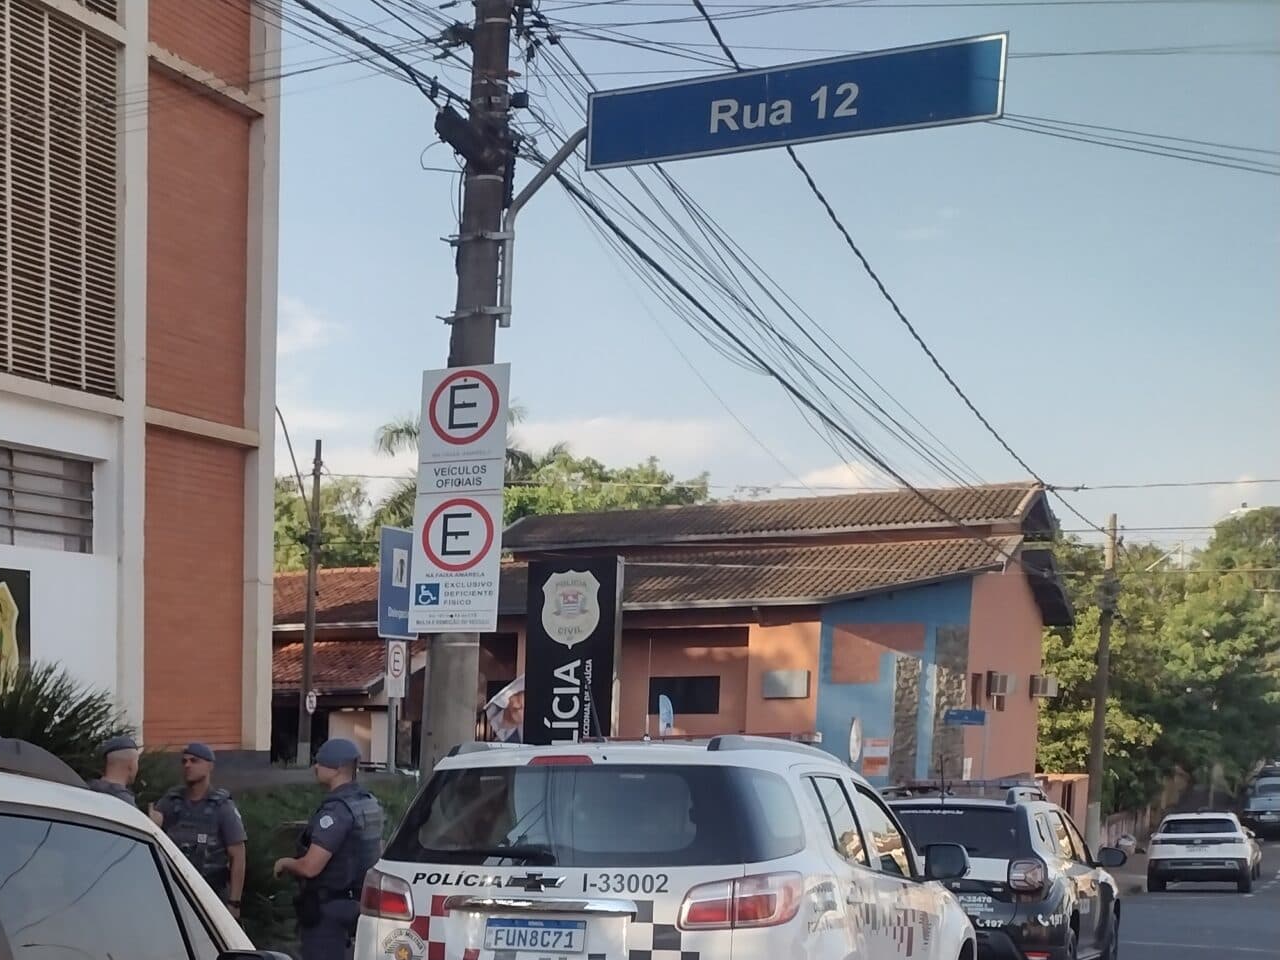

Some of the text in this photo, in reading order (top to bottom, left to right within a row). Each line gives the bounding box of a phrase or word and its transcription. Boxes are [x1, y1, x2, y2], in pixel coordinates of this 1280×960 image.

[709, 82, 859, 134] Rua 12
[448, 383, 480, 429] E
[433, 464, 487, 477] VEÍCULOS
[436, 476, 482, 488] OFICIAIS
[441, 512, 473, 556] E
[557, 626, 583, 636] CIVIL
[393, 651, 401, 672] E
[543, 658, 581, 745] LÍCIA
[582, 701, 591, 736] CCIONAL
[412, 871, 503, 889] POLÍCIA
[582, 873, 669, 894] I-33002
[494, 928, 574, 949] FUN8C71
